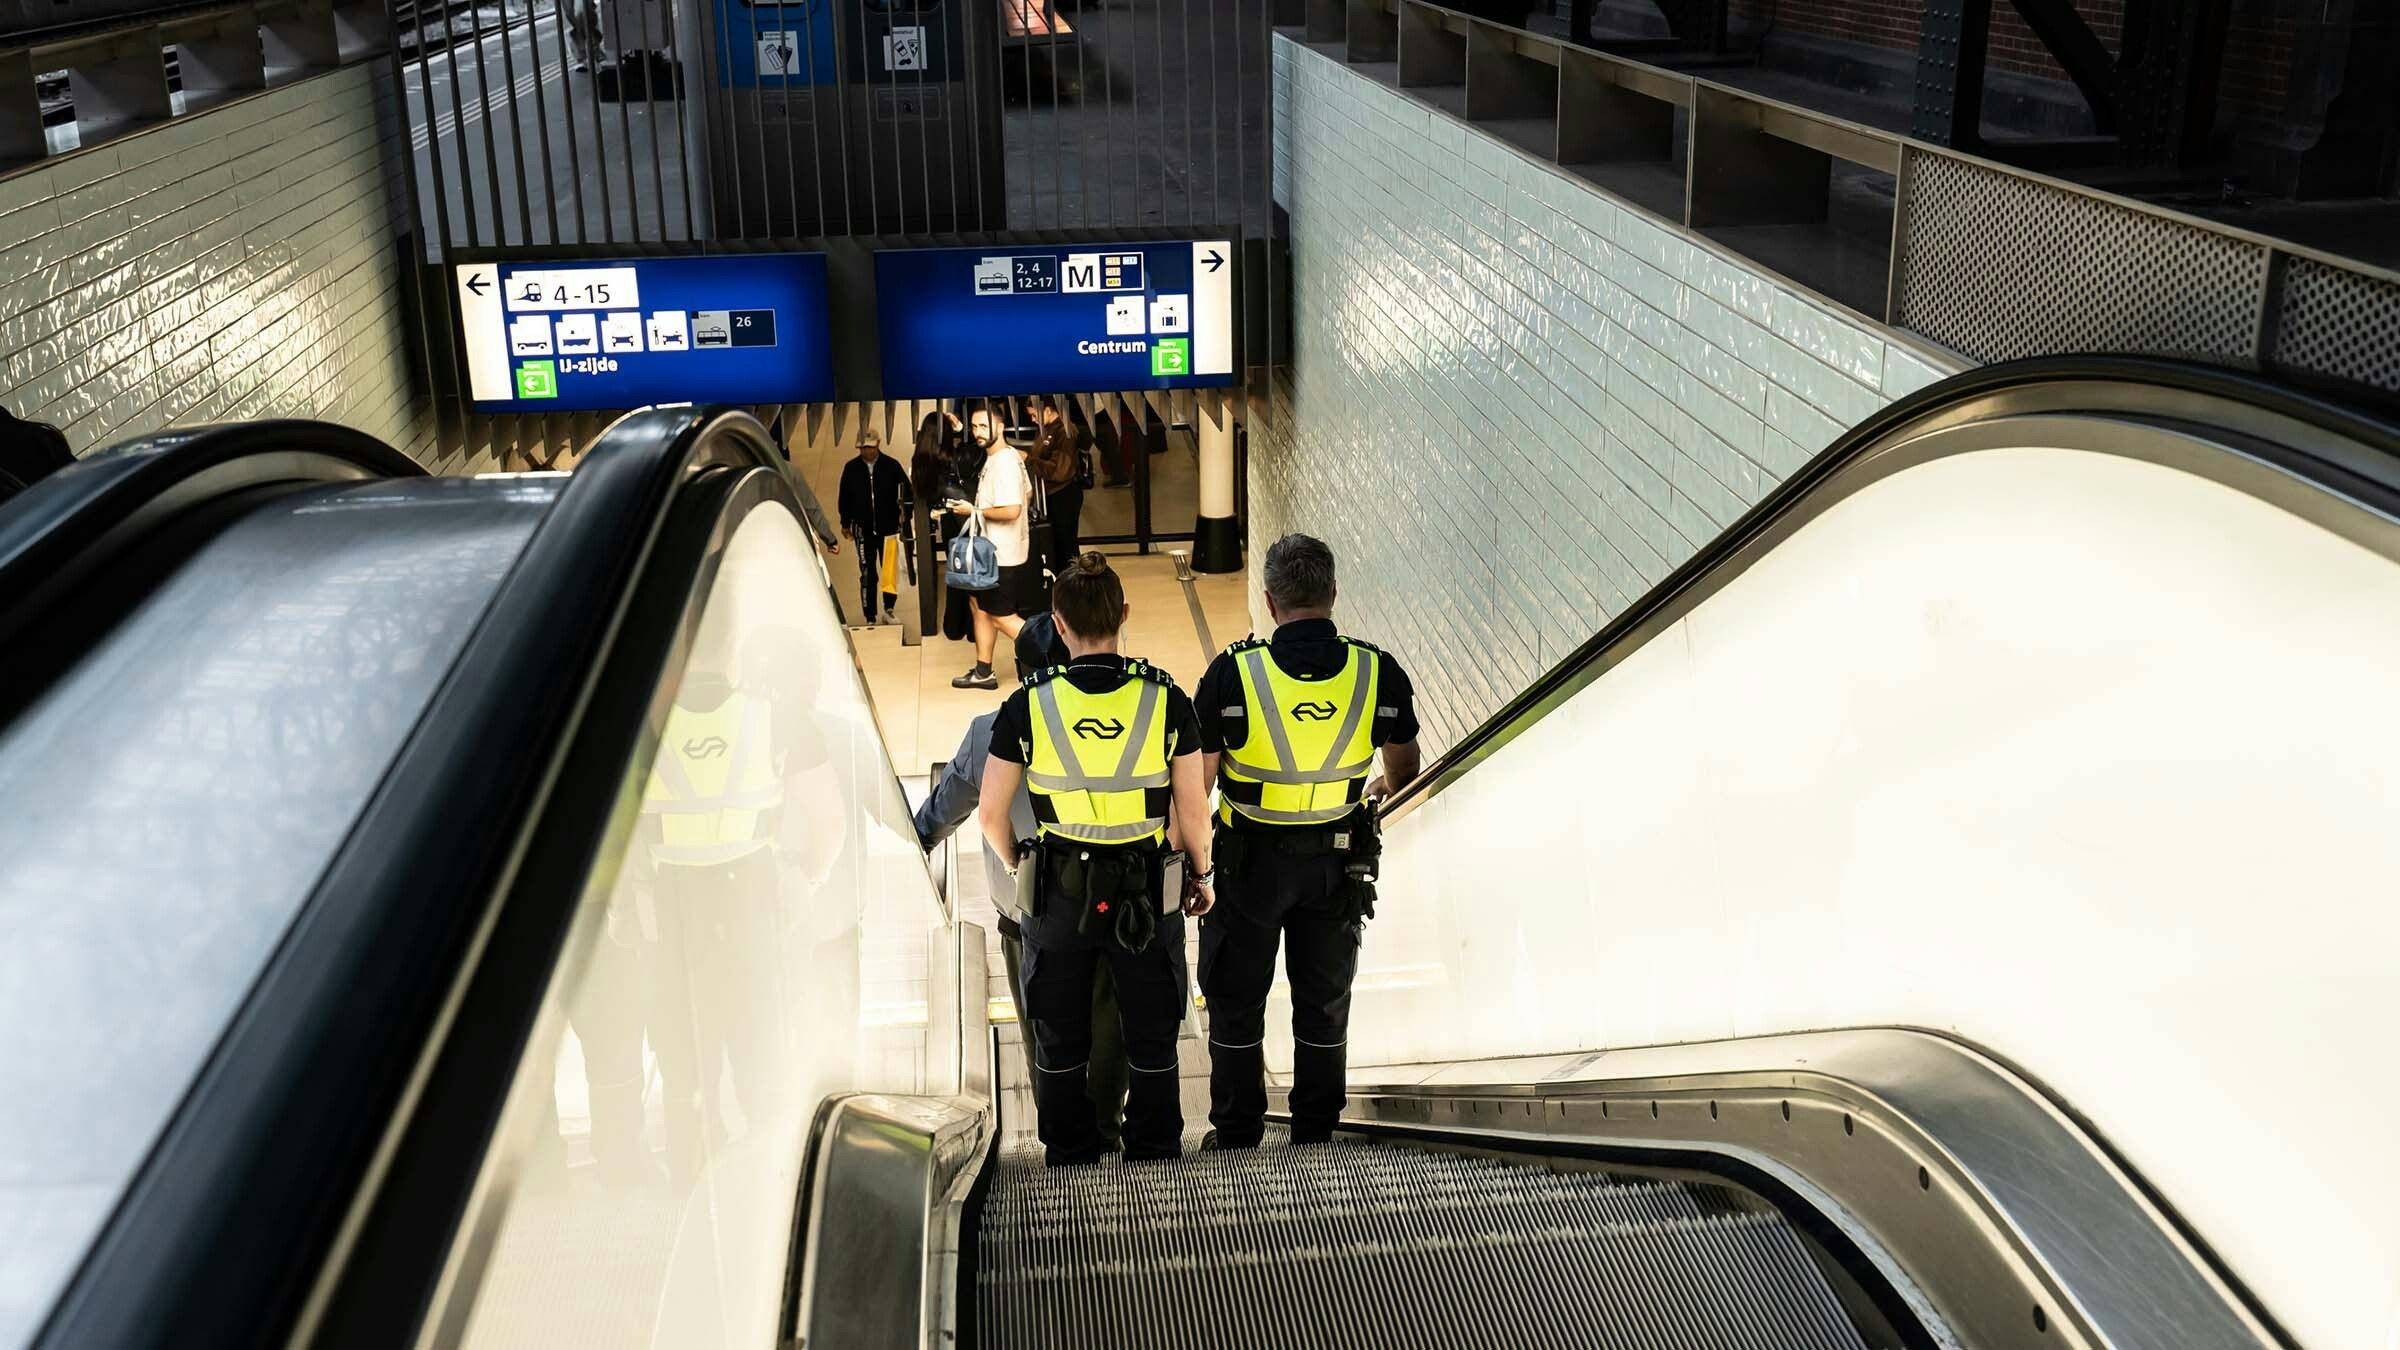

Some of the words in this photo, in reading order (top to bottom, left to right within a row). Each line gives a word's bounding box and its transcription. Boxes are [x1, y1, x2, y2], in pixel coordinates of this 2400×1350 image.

[1032, 262, 1040, 273] 4
[1018, 277, 1053, 288] 12-17
[1068, 265, 1094, 288] M
[735, 316, 752, 327] 26
[1077, 339, 1147, 355] Centrum
[559, 356, 618, 375] IJ-zijde
